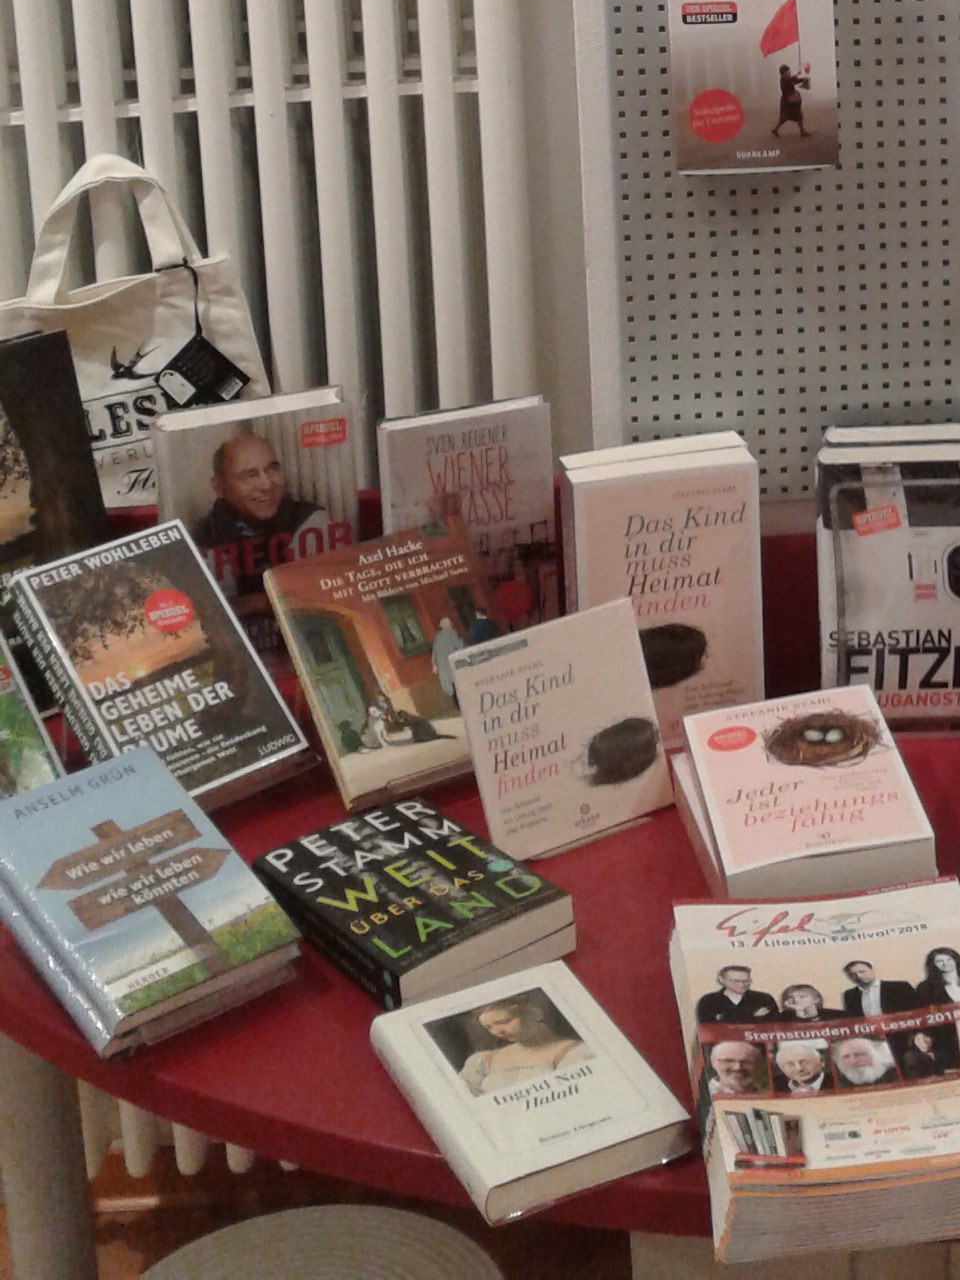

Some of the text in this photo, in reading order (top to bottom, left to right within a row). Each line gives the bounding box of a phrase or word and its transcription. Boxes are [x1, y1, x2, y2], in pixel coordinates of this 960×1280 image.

[426, 424, 508, 455] SVEN REGENER
[427, 445, 514, 496] WIENER
[624, 502, 747, 537] Das Kind
[31, 564, 82, 590] PETER
[84, 528, 182, 570] WOHLLEBEN
[358, 540, 423, 567] Axel Hacke
[625, 529, 698, 558] in dir
[333, 554, 466, 600] MIT VERBRACHTE
[384, 552, 429, 573] DIE ICH
[625, 554, 692, 575] muss
[627, 566, 722, 596] Heimat
[828, 628, 952, 649] SEBASTIAN
[88, 671, 131, 701] DAS
[101, 669, 200, 720] GEHEIME
[479, 664, 574, 715] Das Kind
[110, 681, 235, 743] LEBEN DER
[481, 700, 541, 734] in dir
[258, 733, 296, 756] LUDWIG
[487, 725, 540, 752] muss
[493, 733, 567, 774] Heimat
[14, 764, 137, 820] ANSELM GRÜN
[726, 780, 804, 805] Jeder
[265, 801, 437, 873] PETER
[65, 829, 174, 881] Wie wir leben
[293, 819, 461, 893] STAMM
[98, 854, 203, 906] wie wir leben
[131, 871, 200, 906] könnten
[317, 836, 489, 912] WEIT
[350, 870, 485, 936] ÜBER DAS
[372, 874, 542, 958] LAND
[763, 923, 928, 948] Literatur 2018
[127, 967, 169, 989] HERDER
[744, 1024, 851, 1042] Sternstunden
[854, 1022, 877, 1034] für
[880, 1016, 923, 1032] Leser
[493, 1066, 594, 1107] Ingrid Noll
